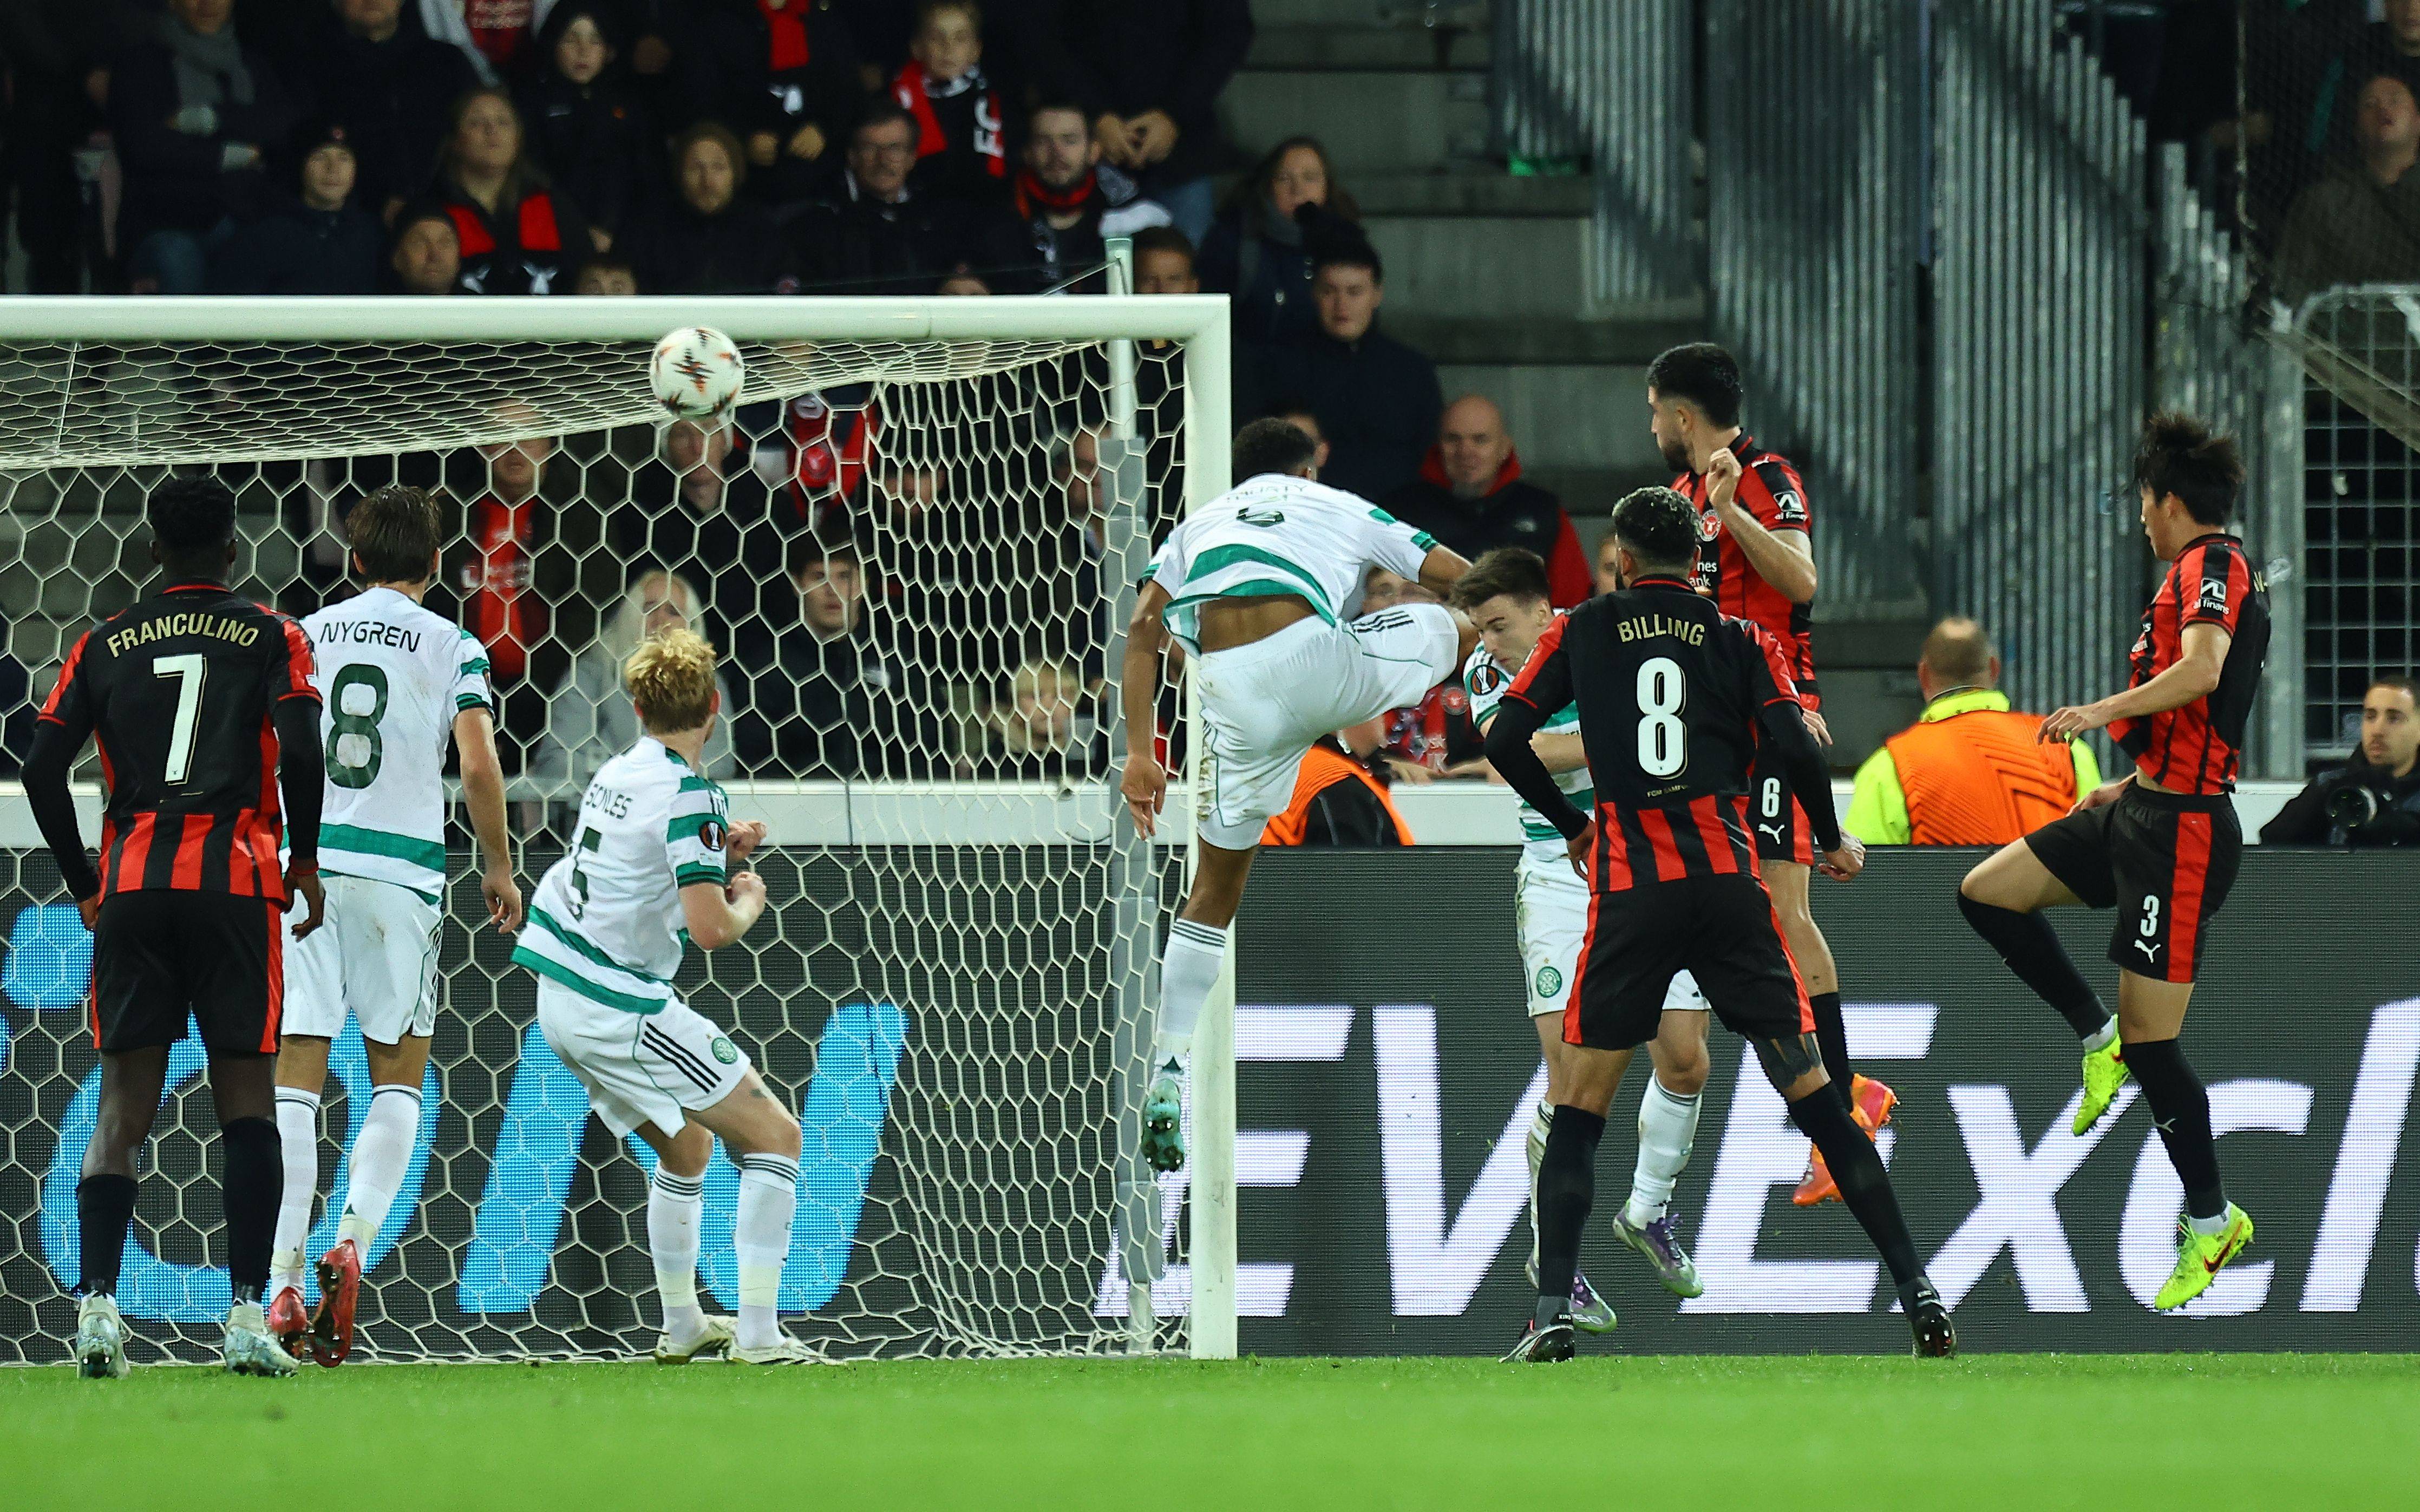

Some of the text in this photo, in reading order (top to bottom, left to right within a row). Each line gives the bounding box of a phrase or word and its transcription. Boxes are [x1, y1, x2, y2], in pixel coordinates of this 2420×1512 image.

[1687, 573, 1711, 587] ank
[107, 613, 259, 658] FRANCULINO
[319, 621, 421, 653] NYGREN
[1617, 613, 1705, 646] BILLING
[153, 653, 207, 786] 7
[325, 664, 388, 789] 8
[1637, 657, 1688, 780] 8
[1762, 777, 1780, 817] 6
[2140, 895, 2160, 937] 3
[1677, 997, 2420, 1319] Excl
